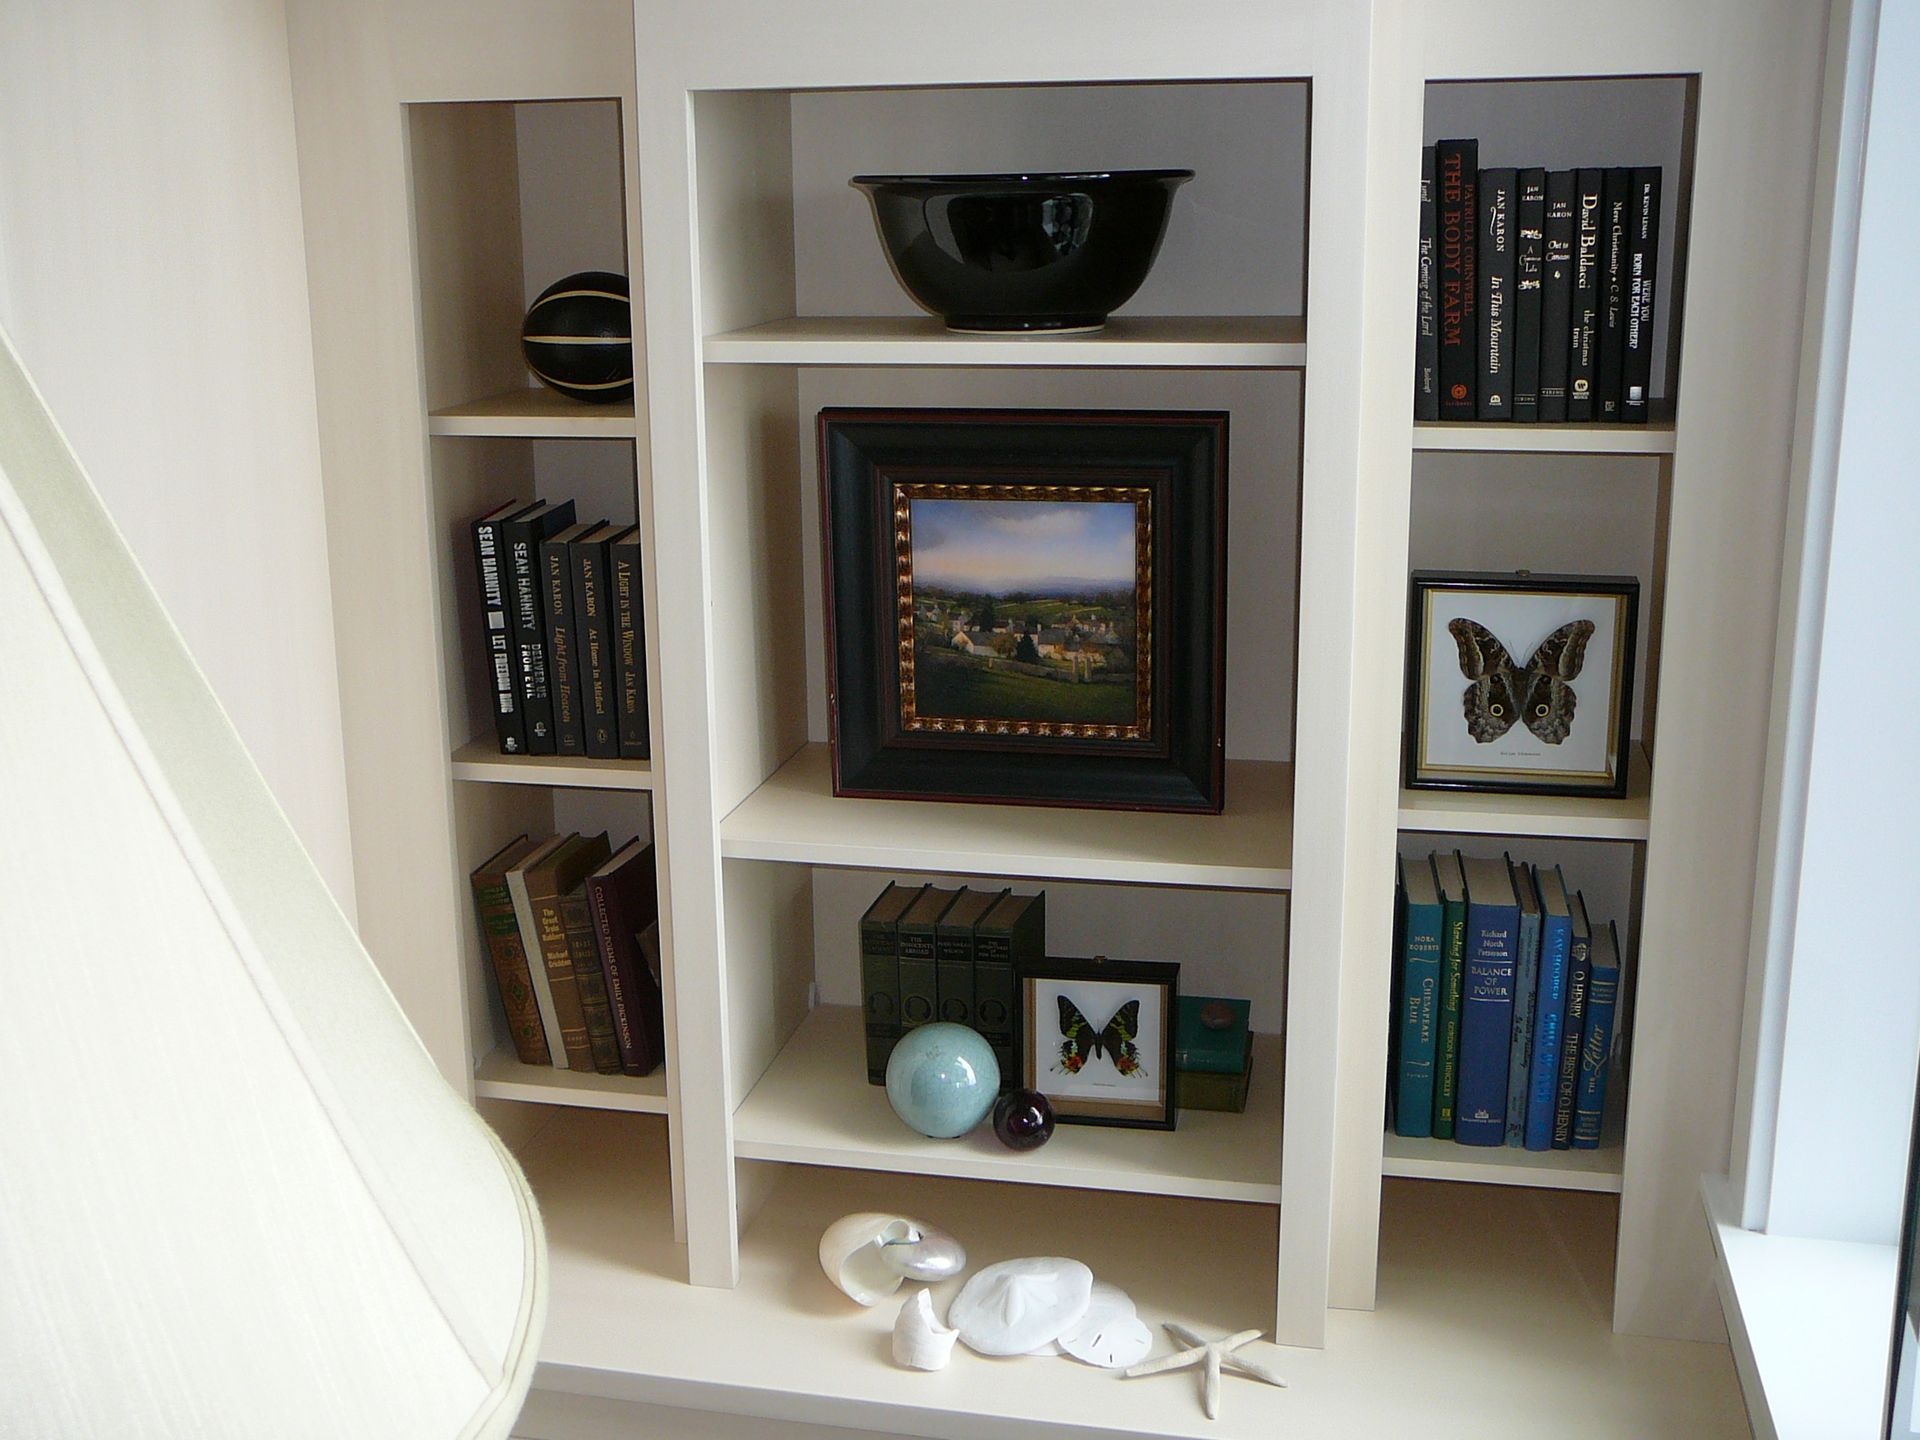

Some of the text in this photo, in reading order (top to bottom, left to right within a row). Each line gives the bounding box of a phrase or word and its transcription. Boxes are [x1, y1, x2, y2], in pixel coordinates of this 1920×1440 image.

[1526, 186, 1539, 194] JAN
[1553, 202, 1566, 210] JAN
[1496, 189, 1505, 253] JAN KARON
[1548, 240, 1561, 249] Out
[1579, 194, 1598, 289] David Baldacci
[1609, 201, 1623, 275] Mere Christianity
[1420, 238, 1431, 255] The
[1444, 153, 1462, 346] THE BODY FARM
[1464, 183, 1474, 316] PATRICIA CORNWELL
[1419, 257, 1431, 289] Coming
[1421, 300, 1433, 313] the
[1629, 253, 1643, 349] BORN FOR EACH OTHER?
[1640, 279, 1652, 322] WERE YOU
[1421, 315, 1433, 336] Lord
[1489, 276, 1503, 374] In This Mountain
[1572, 327, 1580, 348] train
[1582, 310, 1595, 366] the christmas
[478, 526, 502, 606] SEAN HANNITY
[513, 542, 536, 631] SEAN HANNITY
[550, 555, 563, 616] JAN KARON
[583, 558, 596, 617] JAN KARON
[618, 560, 635, 666] A LIGHT IN THE WINDOW
[492, 635, 514, 714] LET FREEDOM RING
[521, 644, 536, 700] FROM EVIL
[531, 644, 547, 699] DELIVER US
[554, 626, 571, 722] Light from Heaven
[589, 628, 605, 715] At Home in Mitford
[625, 671, 637, 714] JAN KARON
[1481, 930, 1507, 938] Richard
[1483, 939, 1504, 948] North
[594, 886, 632, 1049] COLLECTED POEMS OF EMILY DICKINSON
[1447, 921, 1463, 1012] Standing for Something
[1471, 966, 1512, 976] BALANCE
[1474, 986, 1508, 995] POWER
[1409, 997, 1421, 1024] BLUE
[1421, 978, 1434, 1043] CHESAPEAKE
[1569, 983, 1584, 1018] HENRY
[1446, 1021, 1455, 1053] GORDON
[1565, 1033, 1579, 1055] THE
[1583, 1024, 1608, 1077] Letter
[1443, 1062, 1452, 1097] HINCKLEY
[1561, 1082, 1573, 1096] OF
[1562, 1056, 1576, 1081] BEST
[1555, 1109, 1570, 1142] HENRY
